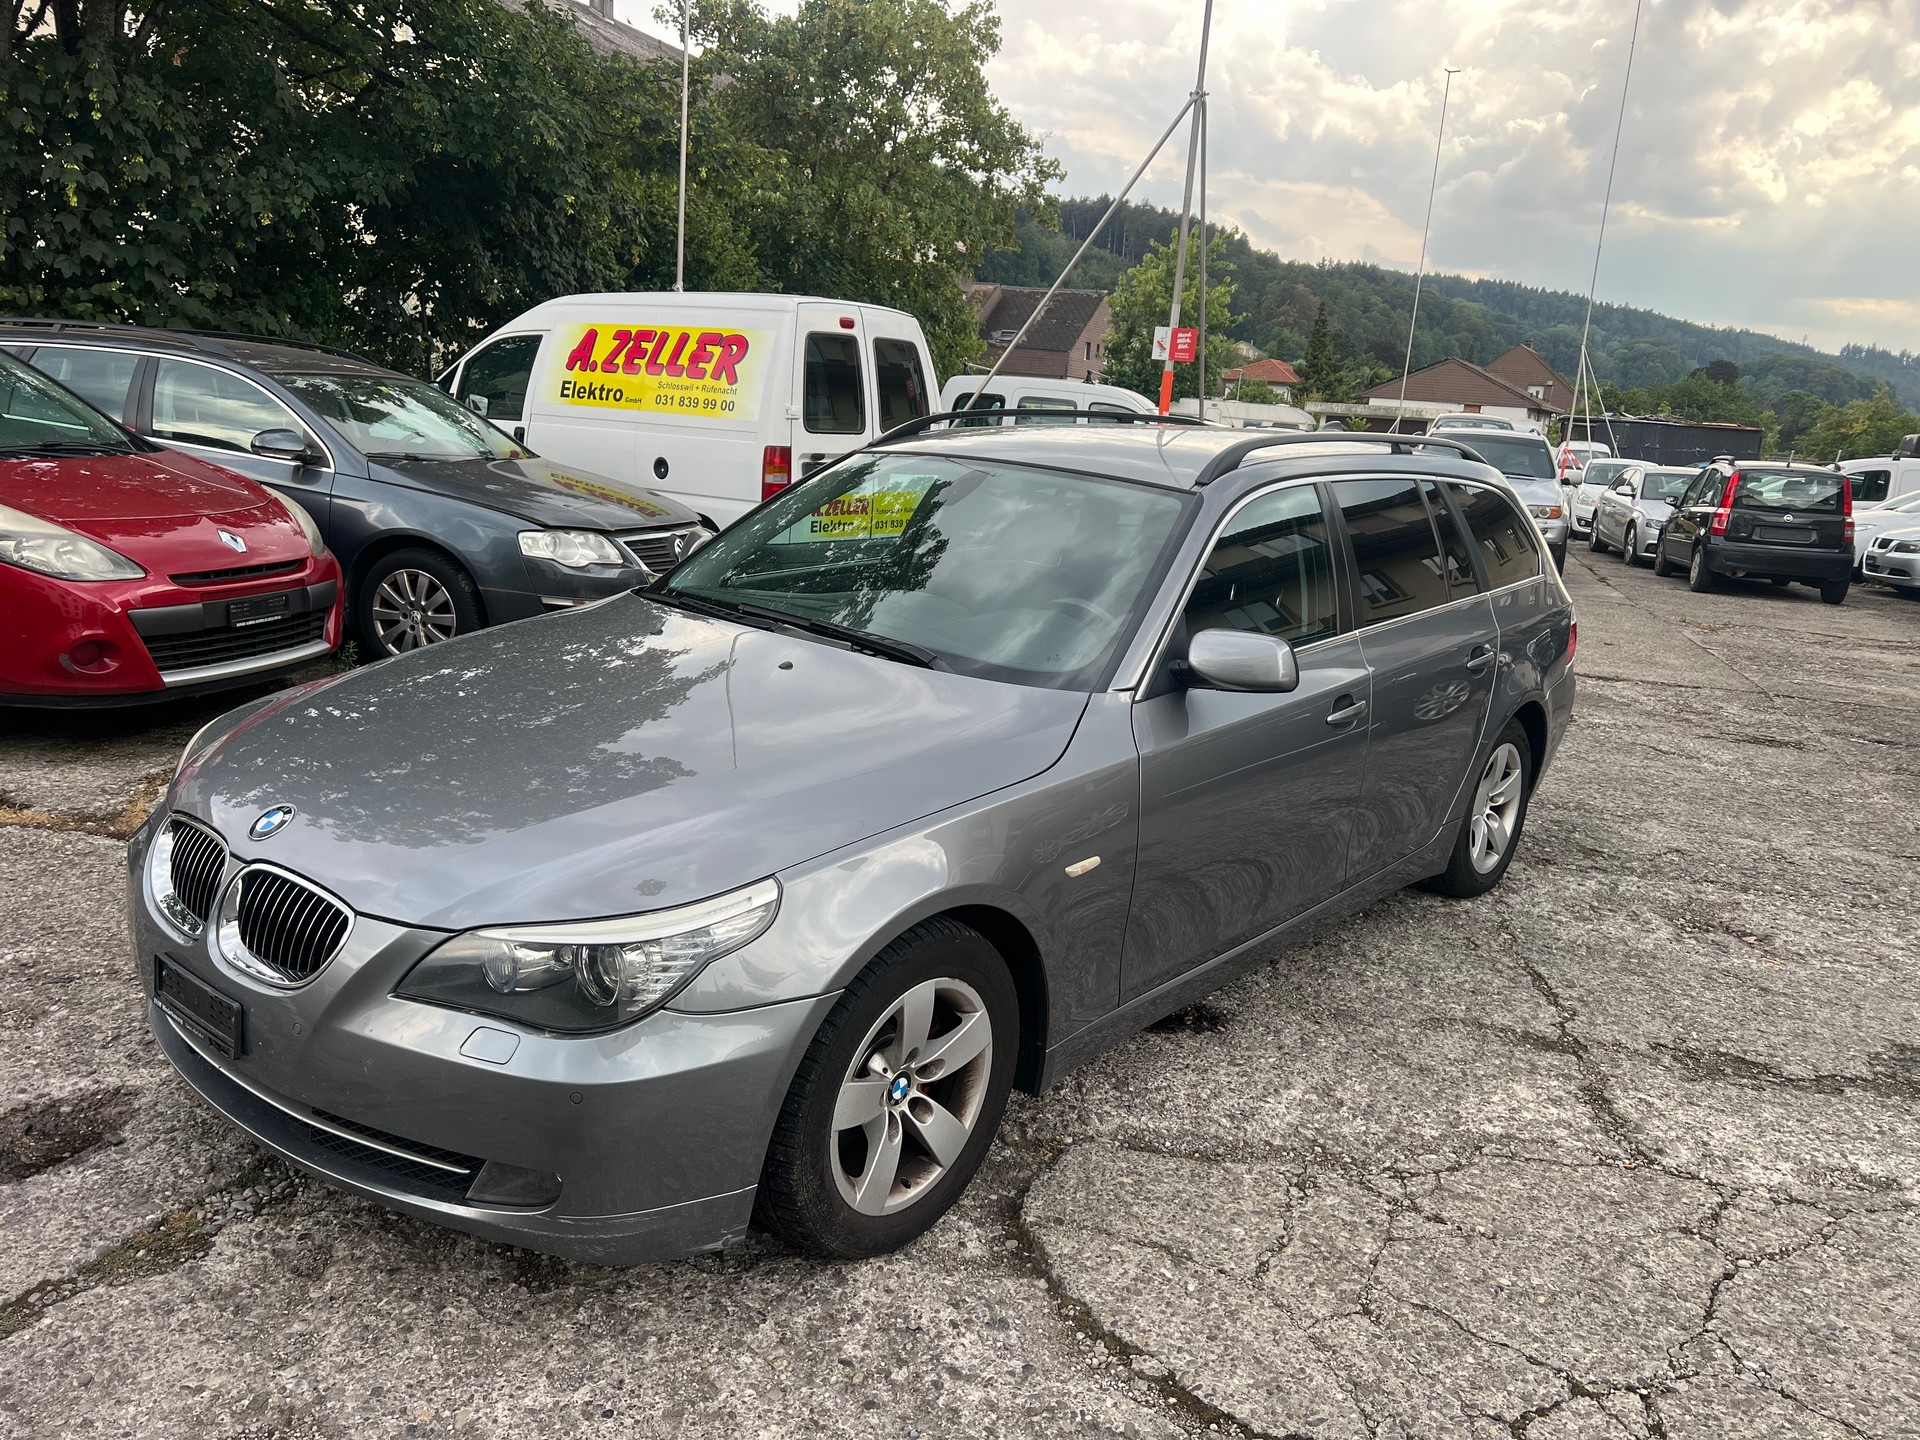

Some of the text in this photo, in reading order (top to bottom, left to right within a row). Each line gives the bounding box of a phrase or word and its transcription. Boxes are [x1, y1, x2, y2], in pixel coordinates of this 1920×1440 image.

[559, 380, 642, 404] Elektro GmbH
[657, 381, 694, 392] Schlosswil
[701, 384, 737, 396] Rüfenacht
[655, 394, 735, 412] 031 839 99 00
[875, 520, 888, 530] 031
[890, 519, 904, 529] 839
